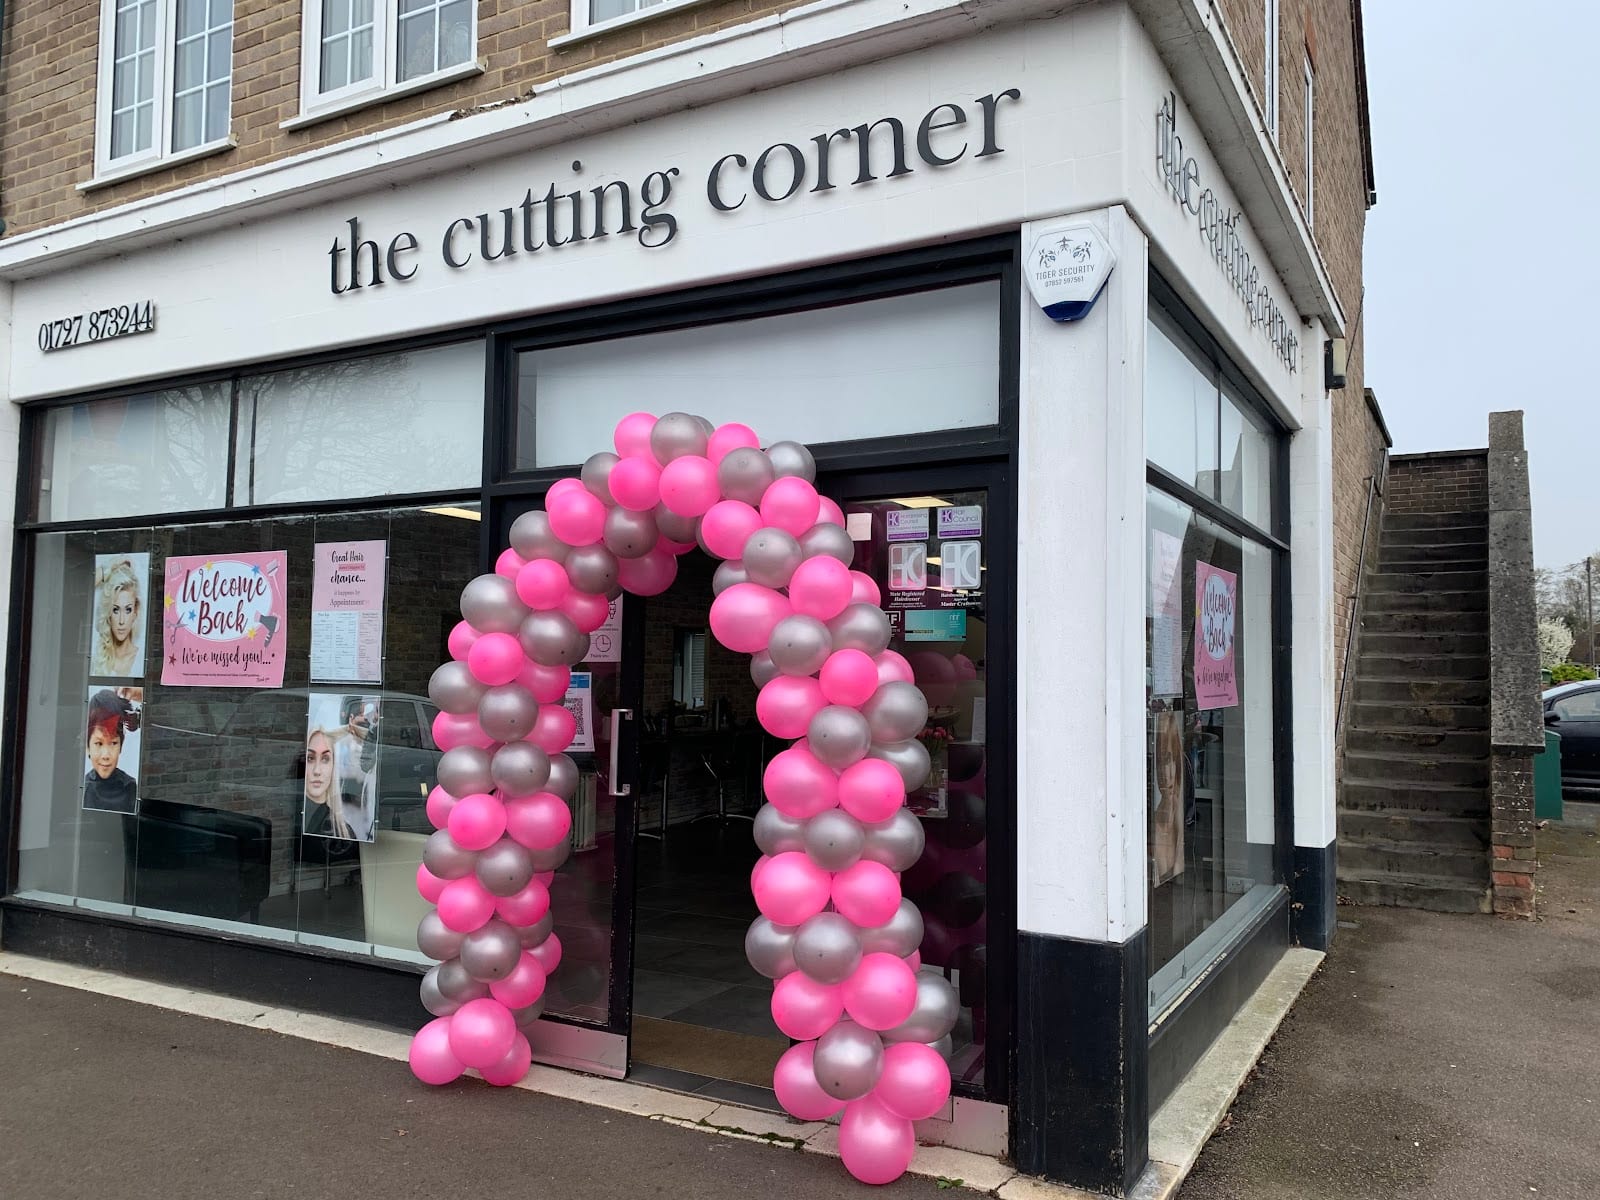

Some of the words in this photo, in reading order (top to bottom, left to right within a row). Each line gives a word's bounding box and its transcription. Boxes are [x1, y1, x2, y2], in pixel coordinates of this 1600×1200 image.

[1156, 90, 1200, 216] the
[329, 216, 419, 295] the
[442, 160, 680, 269] cutting
[707, 87, 1021, 212] corner
[1035, 269, 1057, 281] TIGER
[1058, 264, 1096, 276] SECURITY
[38, 315, 83, 352] 01727
[88, 299, 154, 341] 873244
[331, 550, 348, 563] Great
[349, 550, 365, 563] Hair
[182, 568, 267, 603] Welcome
[330, 570, 366, 585] chance...
[197, 599, 249, 635] Back
[1203, 578, 1232, 620] Welcome
[1208, 615, 1226, 654] Back
[182, 647, 208, 665] We've
[211, 645, 240, 667] missed
